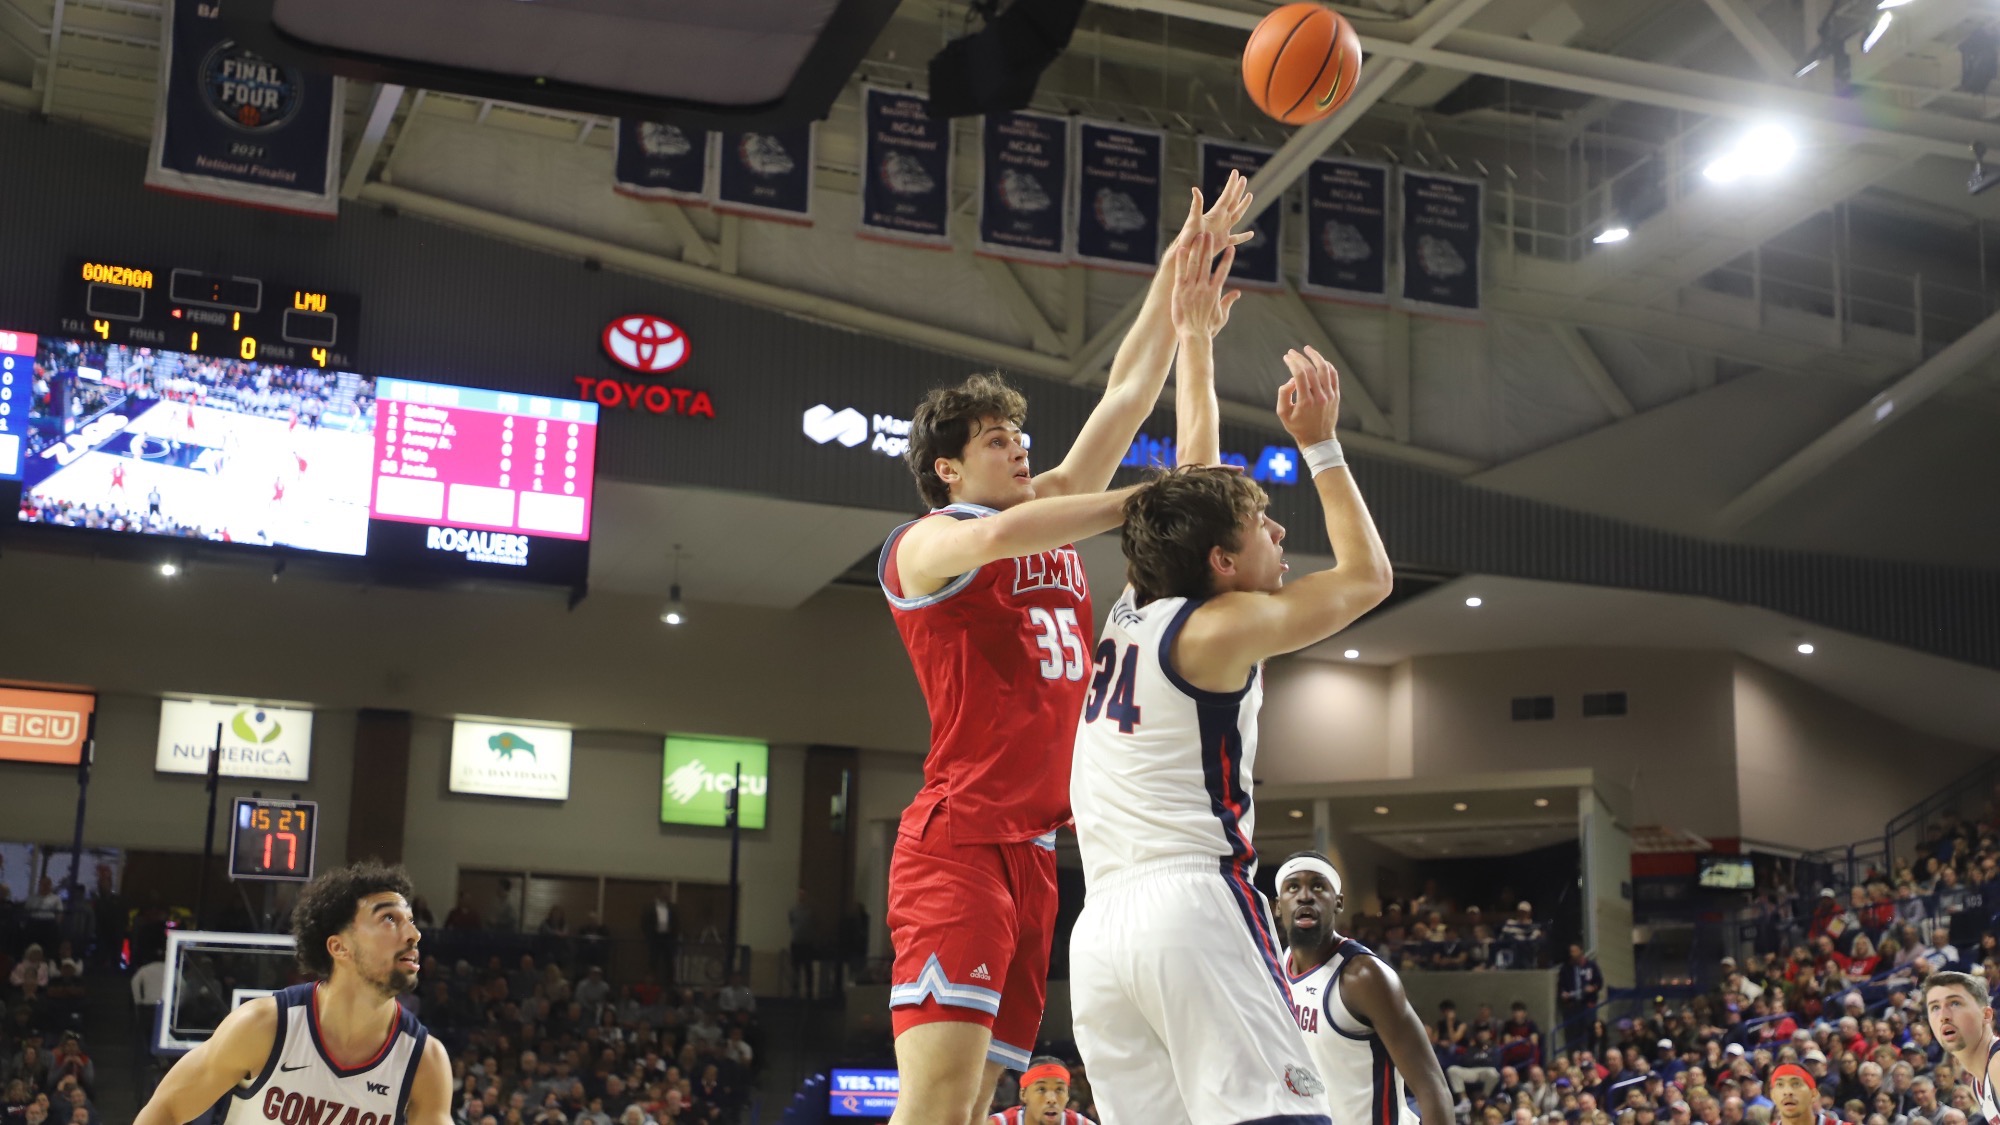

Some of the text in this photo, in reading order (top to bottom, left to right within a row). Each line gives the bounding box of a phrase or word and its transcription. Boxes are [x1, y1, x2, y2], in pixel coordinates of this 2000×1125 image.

[223, 59, 282, 86] FINAL
[222, 81, 279, 110] FOUR
[231, 143, 265, 158] 2021
[1008, 140, 1043, 154] NCAA
[196, 155, 297, 182] National Finalist
[82, 262, 153, 289] GONZAGA
[294, 290, 326, 312] LMU
[94, 319, 110, 339] 4
[186, 308, 241, 331] PERIOD 1
[129, 326, 198, 351] FOULS 1
[240, 336, 295, 360] 0 FOULS
[311, 347, 327, 368] 4
[574, 375, 716, 418] TOYOTA
[503, 415, 514, 430] 4
[567, 423, 579, 437] 0
[502, 429, 513, 443] 0
[535, 433, 547, 447] 0
[566, 436, 578, 450] 0
[385, 444, 396, 459] 7
[500, 457, 512, 472] 0
[564, 465, 576, 479] 0
[501, 443, 513, 457] 0
[565, 449, 577, 464] 0
[563, 481, 575, 495] 0
[426, 525, 529, 558] ROSAUERS
[1012, 548, 1086, 602] LMU
[1029, 607, 1085, 682] 35
[1085, 638, 1141, 735] 34
[263, 832, 298, 871] 17
[969, 972, 992, 981] adidas
